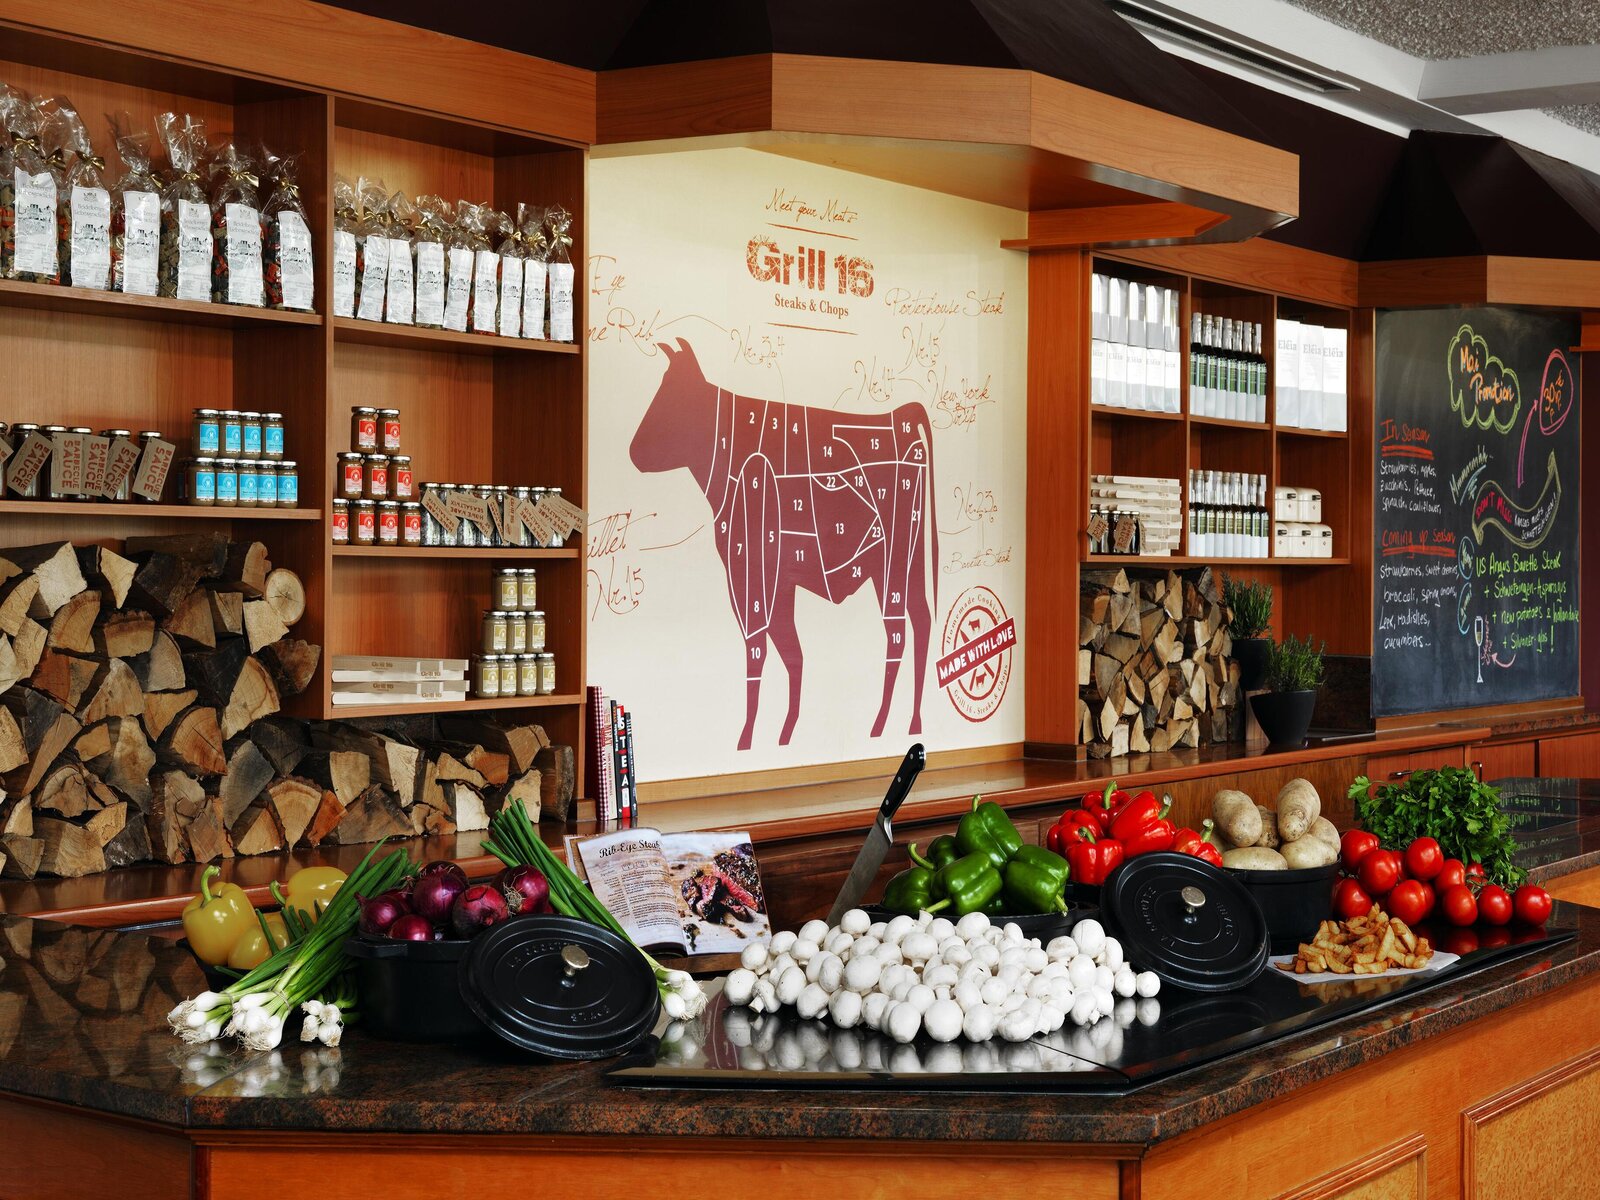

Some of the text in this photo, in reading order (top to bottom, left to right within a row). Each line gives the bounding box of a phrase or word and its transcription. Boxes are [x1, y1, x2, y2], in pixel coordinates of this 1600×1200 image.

[766, 188, 806, 211] Meet
[796, 206, 817, 222] your
[746, 235, 874, 298] Grill 16
[774, 293, 848, 320] Steaks & Chops
[885, 286, 1005, 316] Porterhouse Steak
[607, 307, 661, 357] Rib
[927, 365, 958, 408] New
[750, 413, 754, 424] 2
[773, 418, 778, 429] 3
[792, 423, 798, 434] 4
[902, 422, 910, 433] 16
[1380, 418, 1399, 443] In
[722, 438, 726, 449] 1
[870, 439, 880, 450] 15
[823, 446, 832, 457] 14
[914, 449, 922, 460] 25
[11, 441, 44, 486] SAUCE
[21, 446, 51, 490] BARBECUE
[62, 440, 73, 488] SAUCE
[72, 440, 81, 489] BARBECUE
[85, 443, 100, 490] SAUCE
[94, 443, 107, 491] BARBECUE
[104, 447, 130, 491] SAUCE
[144, 446, 165, 493] SAUCE
[109, 452, 138, 494] BARBECUE
[153, 449, 173, 495] BARBECUE
[752, 478, 758, 488] 6
[826, 477, 836, 488] 22
[855, 476, 863, 486] 18
[902, 479, 910, 490] 19
[878, 488, 886, 500] 17
[794, 500, 802, 510] 12
[912, 510, 920, 521] 21
[721, 522, 726, 532] 9
[836, 524, 844, 534] 13
[872, 527, 881, 538] 23
[769, 532, 774, 542] 5
[737, 544, 742, 554] 7
[796, 550, 804, 561] 11
[1476, 556, 1487, 578] US
[1489, 552, 1510, 578] Angus
[1542, 550, 1562, 570] Steak
[852, 566, 862, 578] 24
[892, 592, 900, 603] 20
[754, 602, 760, 612] 8
[946, 594, 1001, 644] Homemade Cooking
[892, 632, 900, 644] 10
[751, 648, 760, 658] 10
[938, 626, 1014, 680] MADE WITH LOVE
[599, 839, 660, 858] Rib-Eye Steak
